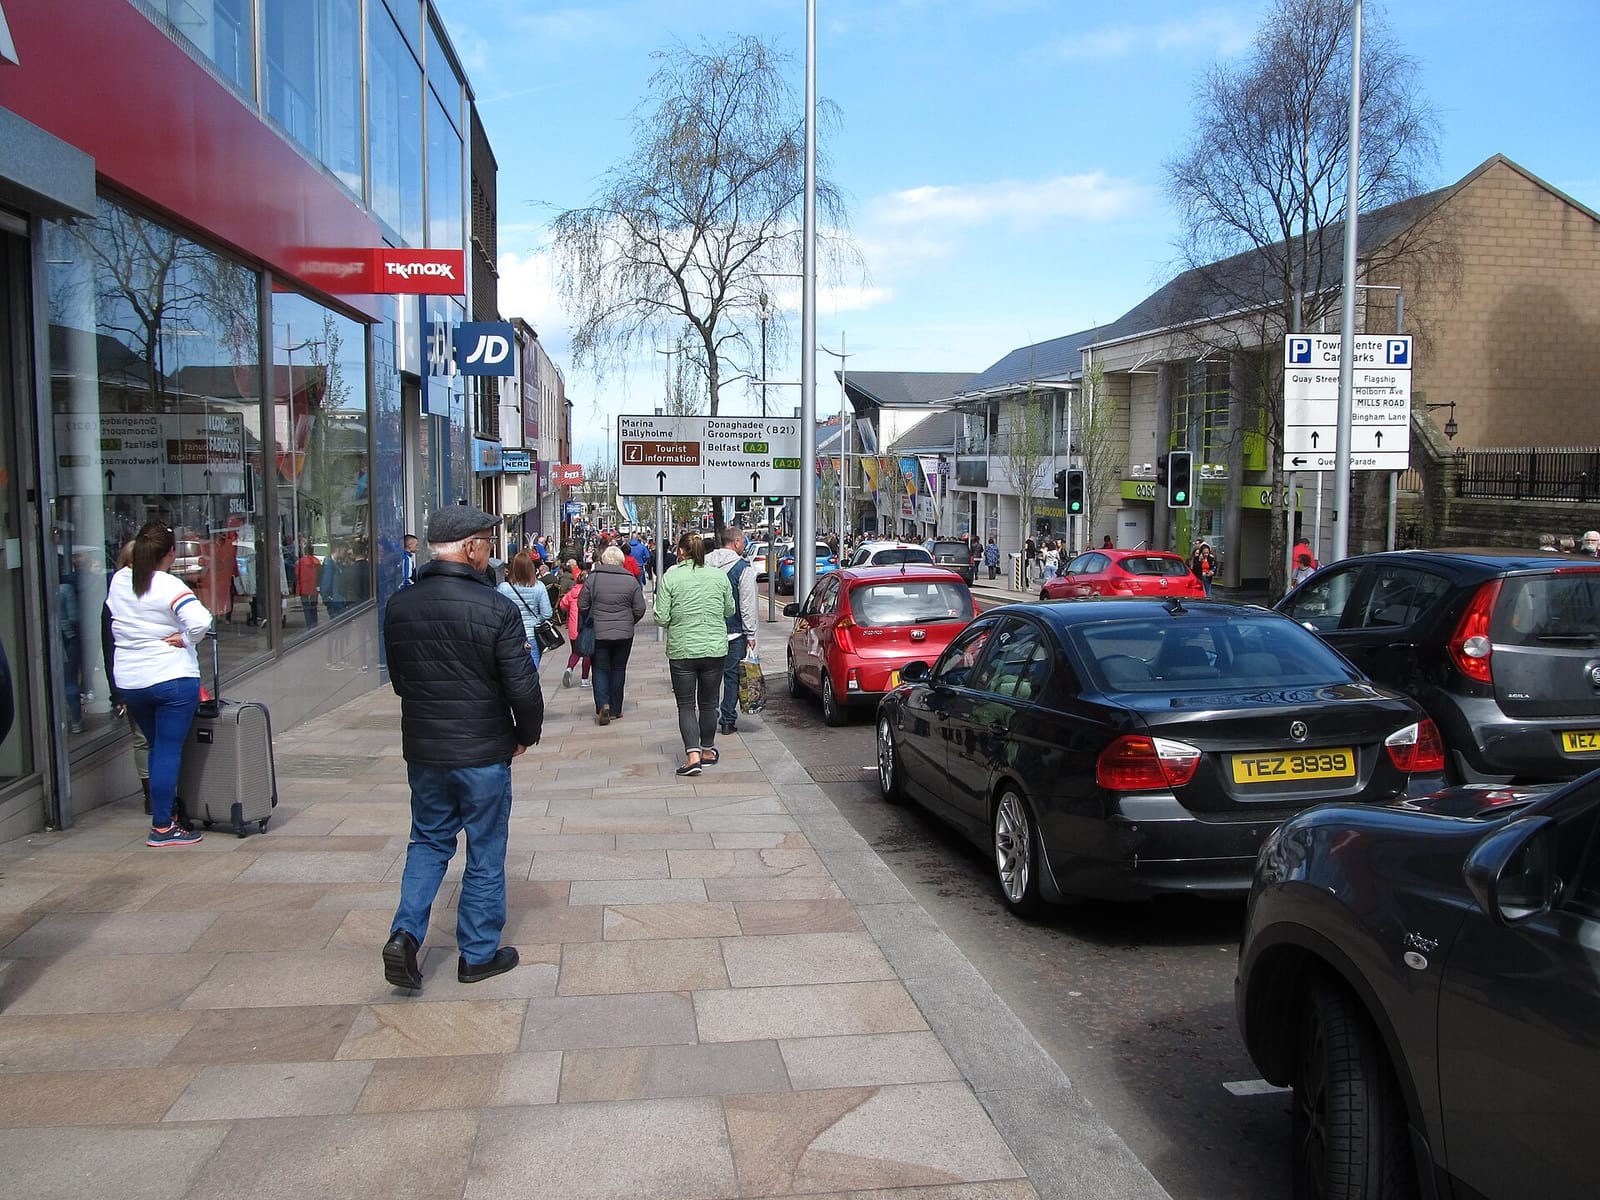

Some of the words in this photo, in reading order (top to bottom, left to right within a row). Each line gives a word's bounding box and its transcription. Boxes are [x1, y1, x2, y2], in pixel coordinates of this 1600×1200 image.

[466, 335, 509, 363] JD
[1355, 340, 1383, 350] entre
[1353, 352, 1375, 362] arks
[1292, 375, 1313, 384] Quay
[1364, 375, 1396, 385] Flagship
[1355, 387, 1386, 395] Holborn
[1389, 387, 1404, 395] Ave
[1357, 399, 1380, 407] MILLS
[1383, 399, 1405, 407] ROAD
[1352, 412, 1386, 421] Bingham
[1388, 412, 1407, 420] Lane
[621, 419, 654, 428] Marina
[707, 420, 764, 430] Donaghadee
[621, 429, 673, 438] Ballyholme
[707, 430, 762, 440] Groomsport
[655, 444, 687, 453] Tourist
[707, 443, 740, 452] Belfast
[744, 443, 768, 453] (A2)
[707, 459, 771, 468] Newtownards
[1350, 457, 1376, 465] Parade
[1568, 733, 1597, 749] WEZ
[1241, 758, 1287, 776] TEZ
[1290, 754, 1347, 774] 3939
